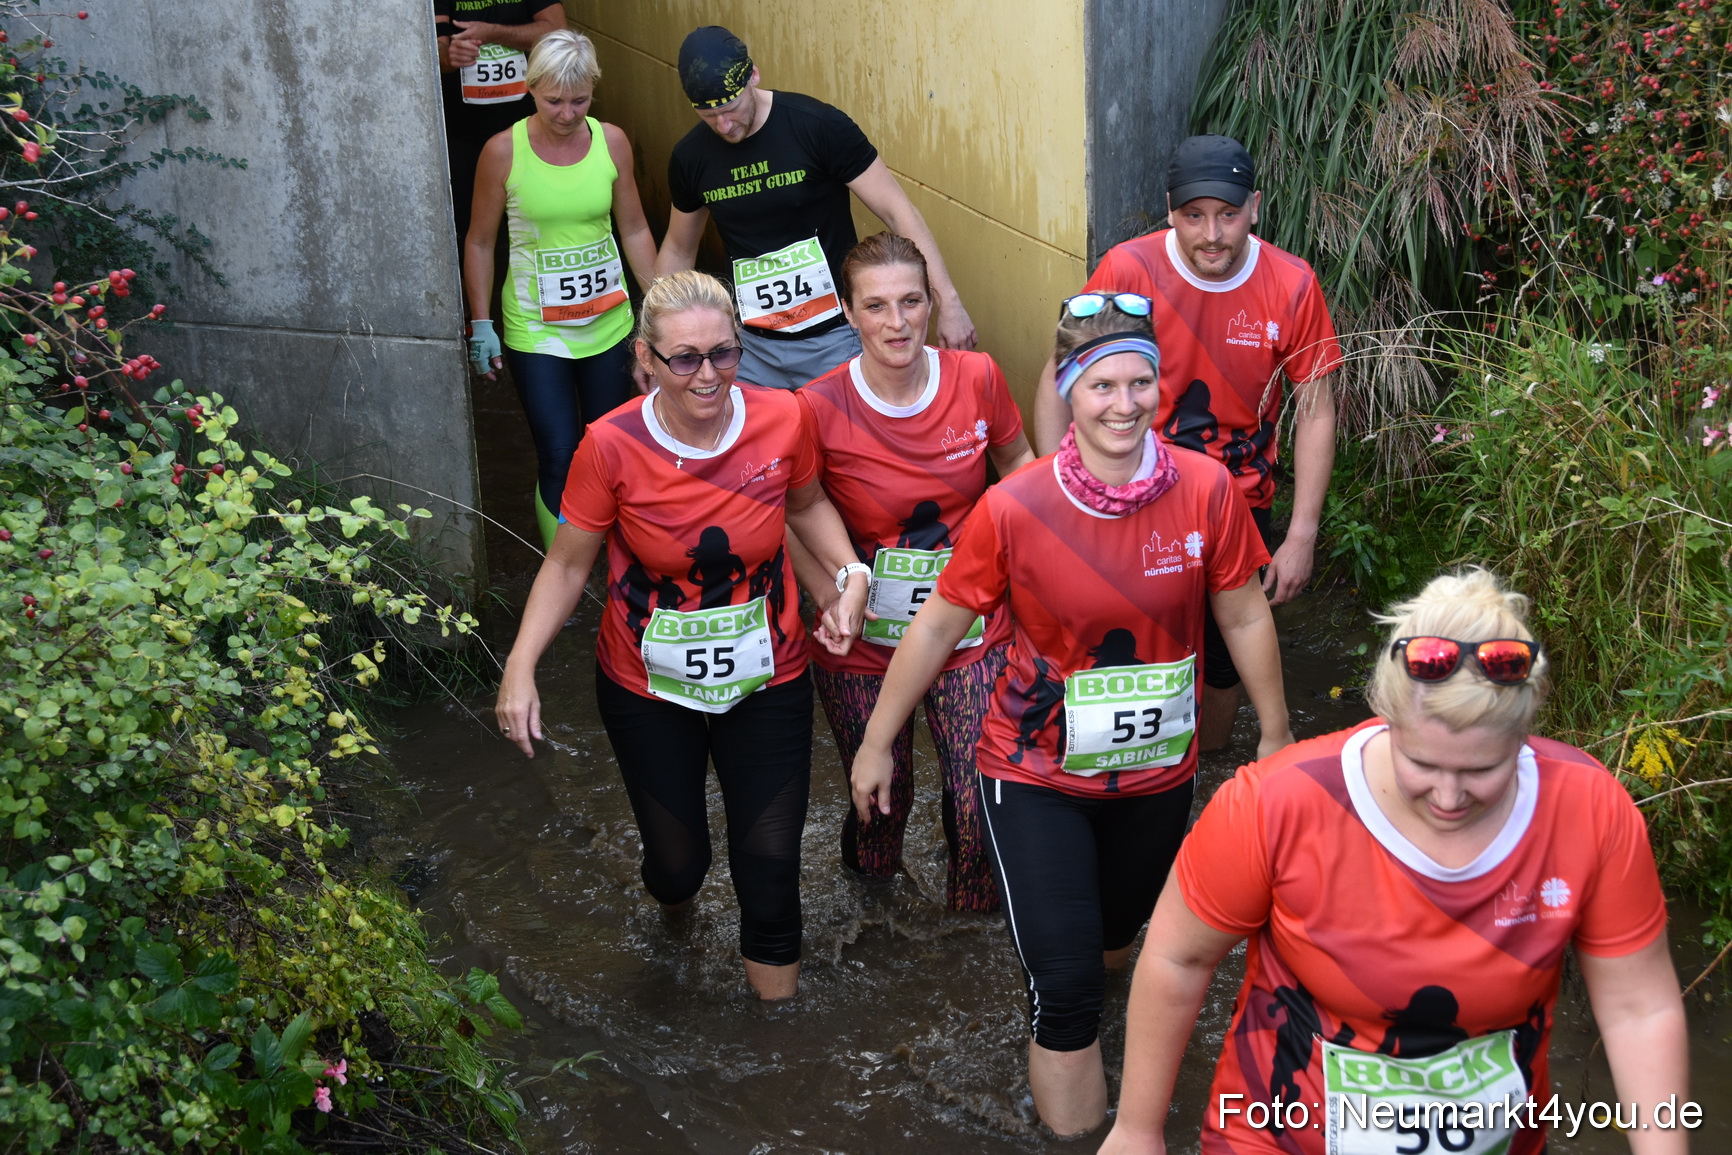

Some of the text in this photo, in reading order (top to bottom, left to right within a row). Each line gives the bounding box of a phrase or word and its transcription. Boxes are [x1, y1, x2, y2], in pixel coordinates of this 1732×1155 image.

[477, 61, 516, 82] 536
[731, 160, 770, 182] TEAM
[703, 169, 807, 204] FORREST GUMP
[544, 243, 611, 270] BOCK
[741, 246, 813, 280] BOCK
[560, 269, 607, 300] 535
[756, 274, 813, 310] 534
[1226, 338, 1261, 348] nürnberg
[1238, 332, 1261, 340] caritas
[946, 448, 976, 461] nürnberg
[884, 552, 952, 578] BOC
[1144, 565, 1183, 577] nürnberg
[1157, 556, 1182, 566] caritas
[908, 588, 932, 616] 5
[654, 607, 755, 639] BOCK
[686, 647, 735, 680] 55
[681, 683, 742, 702] TANJA
[1076, 667, 1188, 700] BOCK
[1111, 708, 1163, 744] 53
[1095, 742, 1169, 768] SABINE
[1340, 1041, 1499, 1094] BOCK
[1395, 1106, 1475, 1154] 56
